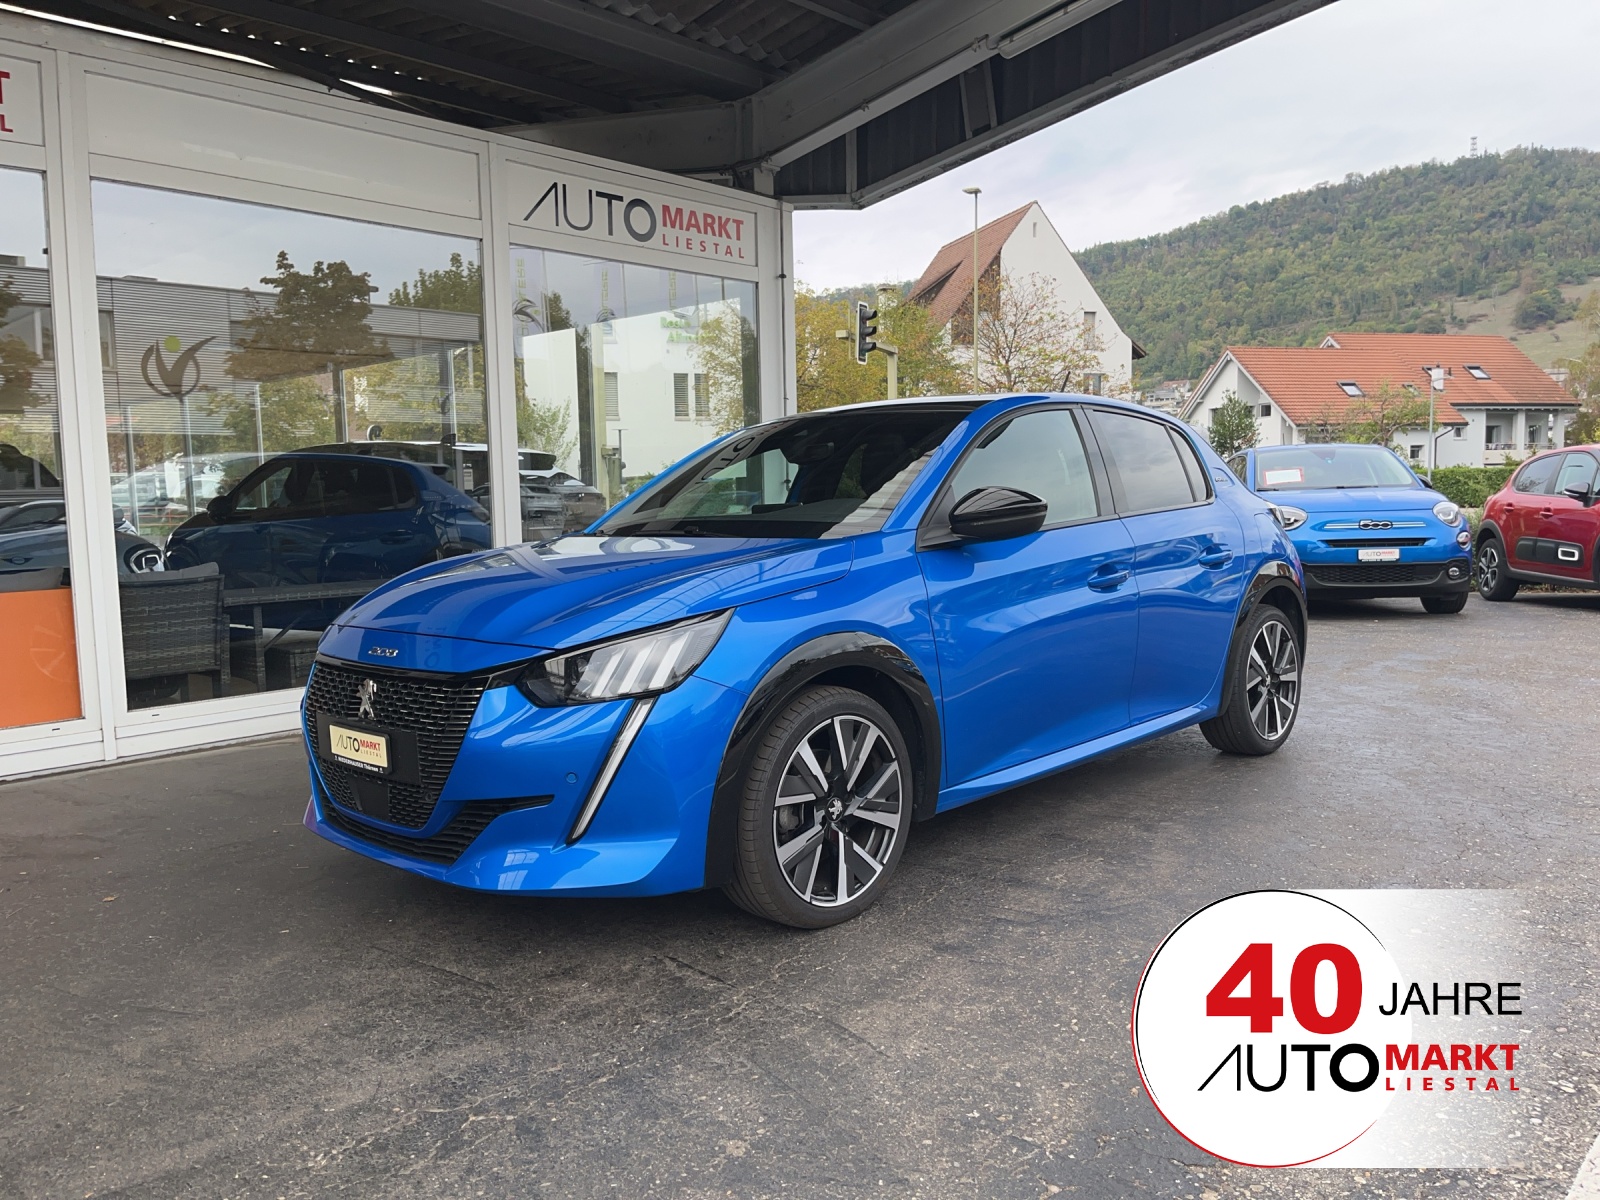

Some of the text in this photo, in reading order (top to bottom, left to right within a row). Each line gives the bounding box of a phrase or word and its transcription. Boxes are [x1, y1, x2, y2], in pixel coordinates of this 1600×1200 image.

[523, 182, 744, 242] AUTO MARKT
[662, 233, 745, 259] LIESTAL
[1360, 520, 1392, 530] 500
[368, 646, 399, 657] 208
[336, 734, 381, 753] AUTO MARKT
